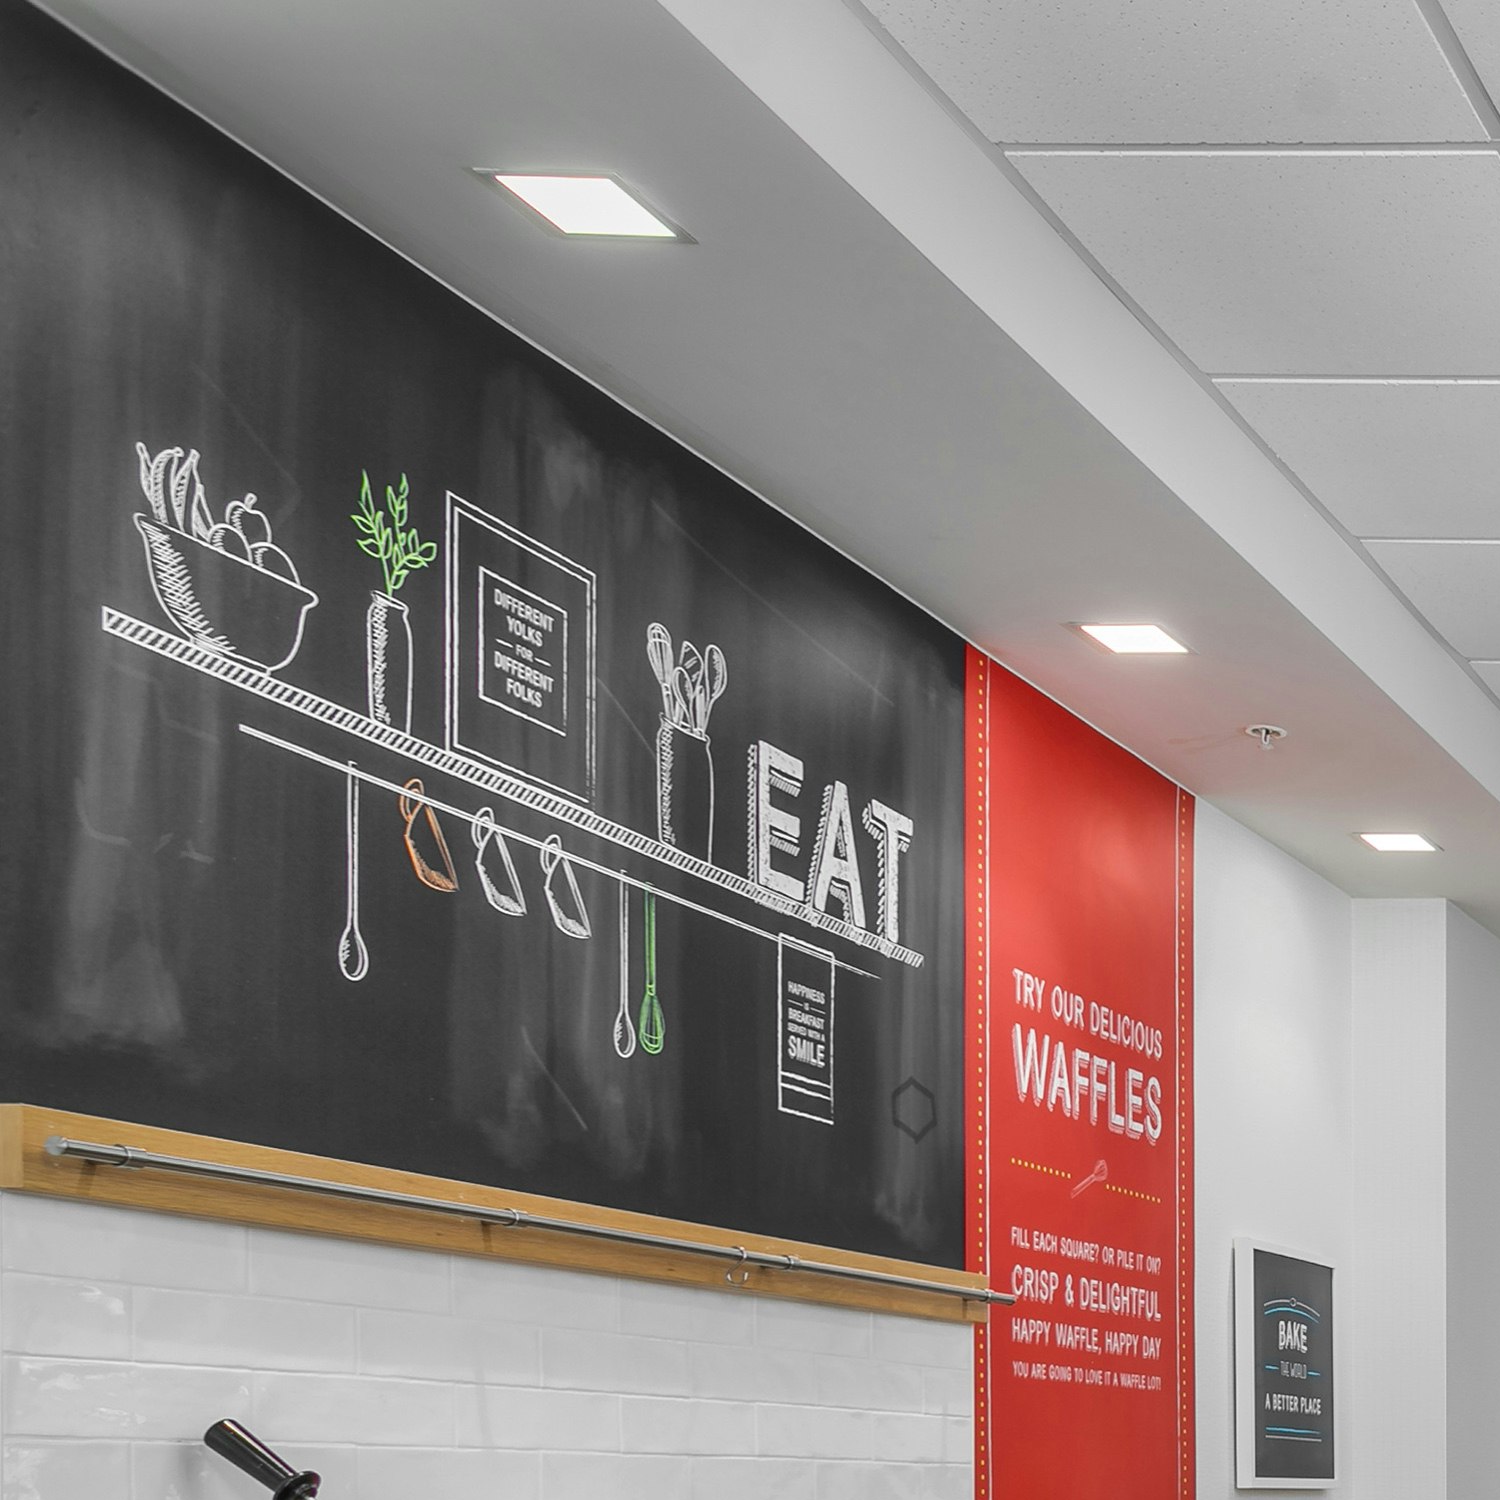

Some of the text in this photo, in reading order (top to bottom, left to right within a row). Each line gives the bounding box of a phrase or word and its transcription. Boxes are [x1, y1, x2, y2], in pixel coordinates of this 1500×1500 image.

[494, 588, 554, 632] DIFFERENT
[506, 615, 542, 647] YOLKS
[515, 644, 534, 662] FOR
[494, 650, 554, 692] DIFFERENT
[506, 678, 542, 707] FOLKS
[748, 739, 914, 945] EAT
[787, 980, 825, 1004] HAPPINESS
[788, 1007, 825, 1030] BREAKFAST
[1012, 968, 1162, 1061] TRY OUR DELICIOUS
[787, 1035, 825, 1068] SMILE
[1012, 1022, 1162, 1146] WAFFLES
[1011, 1226, 1161, 1276] FILL EACH SQUARE? OR PILE IT ON?
[1012, 1263, 1162, 1322] CRISP & DELIGHTFUL
[1011, 1317, 1161, 1360] HAPPY WAFFLE, HAPPY DAY
[1278, 1320, 1308, 1353] BAKE
[1012, 1360, 1029, 1378] YOU
[1031, 1363, 1046, 1380] ARE
[1048, 1364, 1072, 1382] GOING
[1073, 1367, 1084, 1383] TO
[1085, 1368, 1103, 1385] LOVE
[1104, 1371, 1111, 1386] IT
[1113, 1372, 1119, 1387] A
[1120, 1373, 1146, 1389] WAFFLE
[1264, 1392, 1321, 1415] A BETTER PLACE
